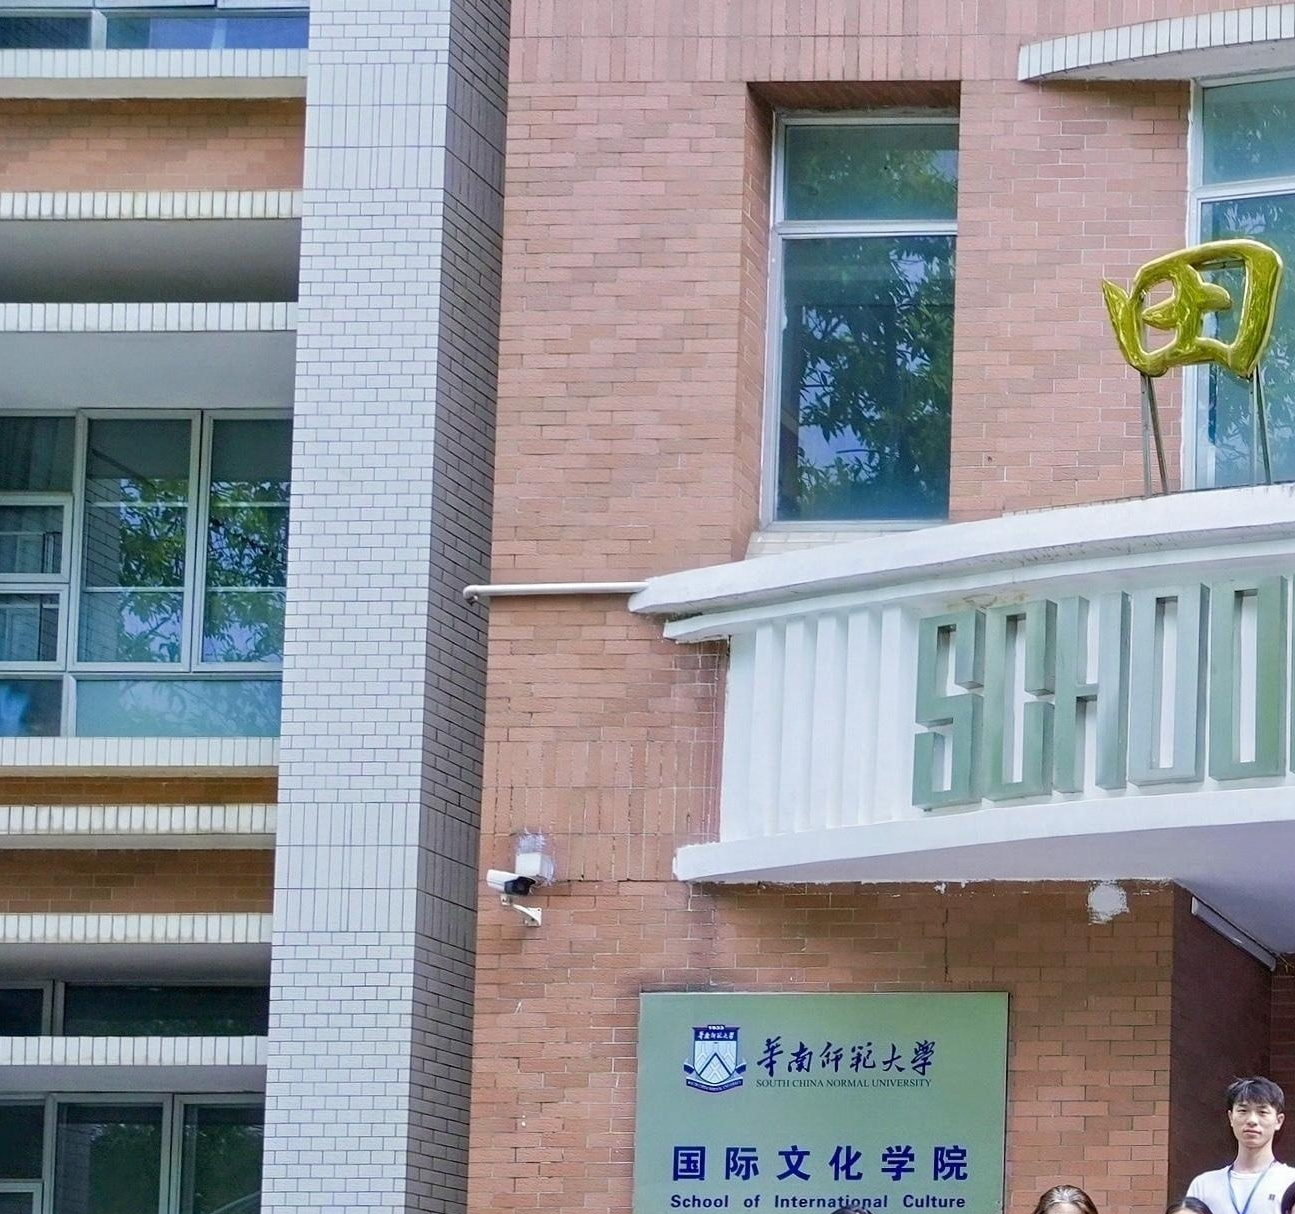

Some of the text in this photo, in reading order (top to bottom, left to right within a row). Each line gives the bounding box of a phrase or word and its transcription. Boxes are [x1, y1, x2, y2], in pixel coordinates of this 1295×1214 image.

[756, 1079, 932, 1088] SOUTH CHINA NORMAL UNIVERSITY
[672, 1144, 969, 1182] 国际文化学院
[670, 1194, 966, 1208] School of International Culture
